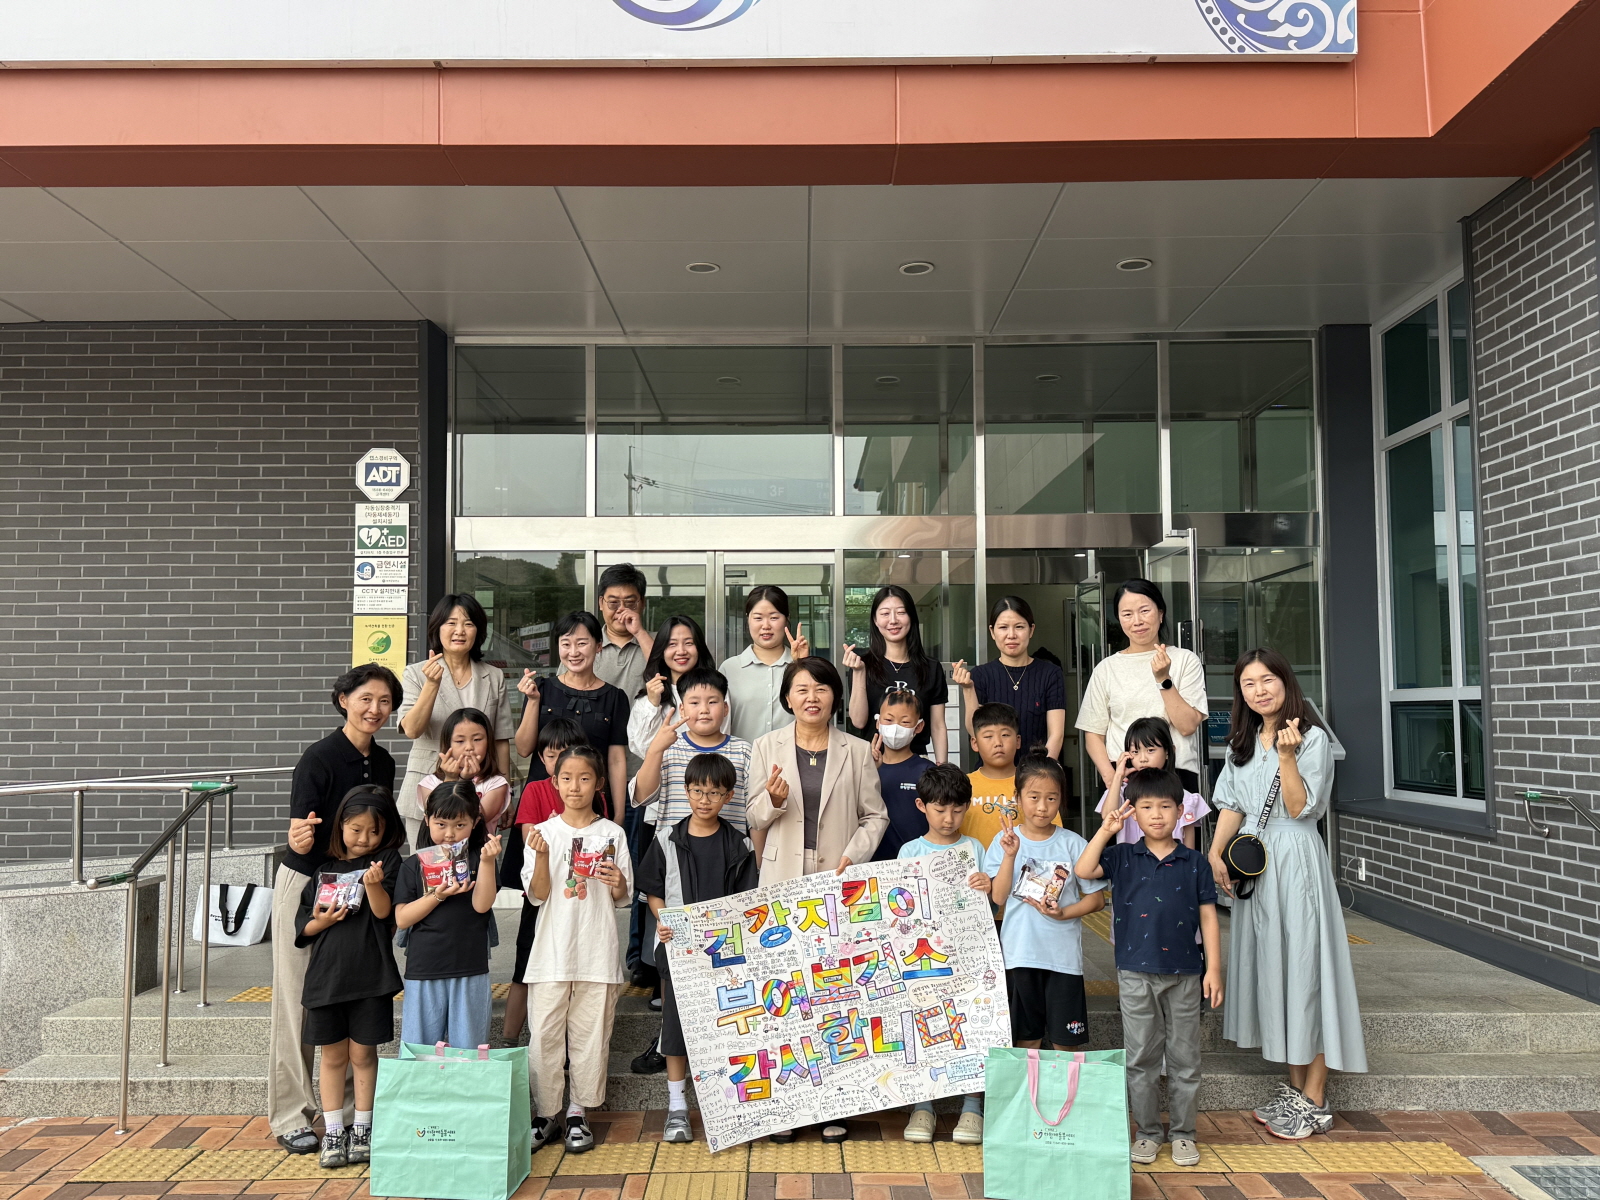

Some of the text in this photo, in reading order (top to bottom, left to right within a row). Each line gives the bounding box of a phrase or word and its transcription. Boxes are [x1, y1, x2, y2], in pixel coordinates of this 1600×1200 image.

[366, 466, 400, 483] ADT
[769, 485, 784, 498] 3F
[378, 536, 406, 548] AED
[376, 560, 406, 568] 금연시설
[704, 877, 932, 968] 건강지킴이
[716, 938, 953, 1036] 부여보건소
[728, 998, 968, 1103] 감사합니다
